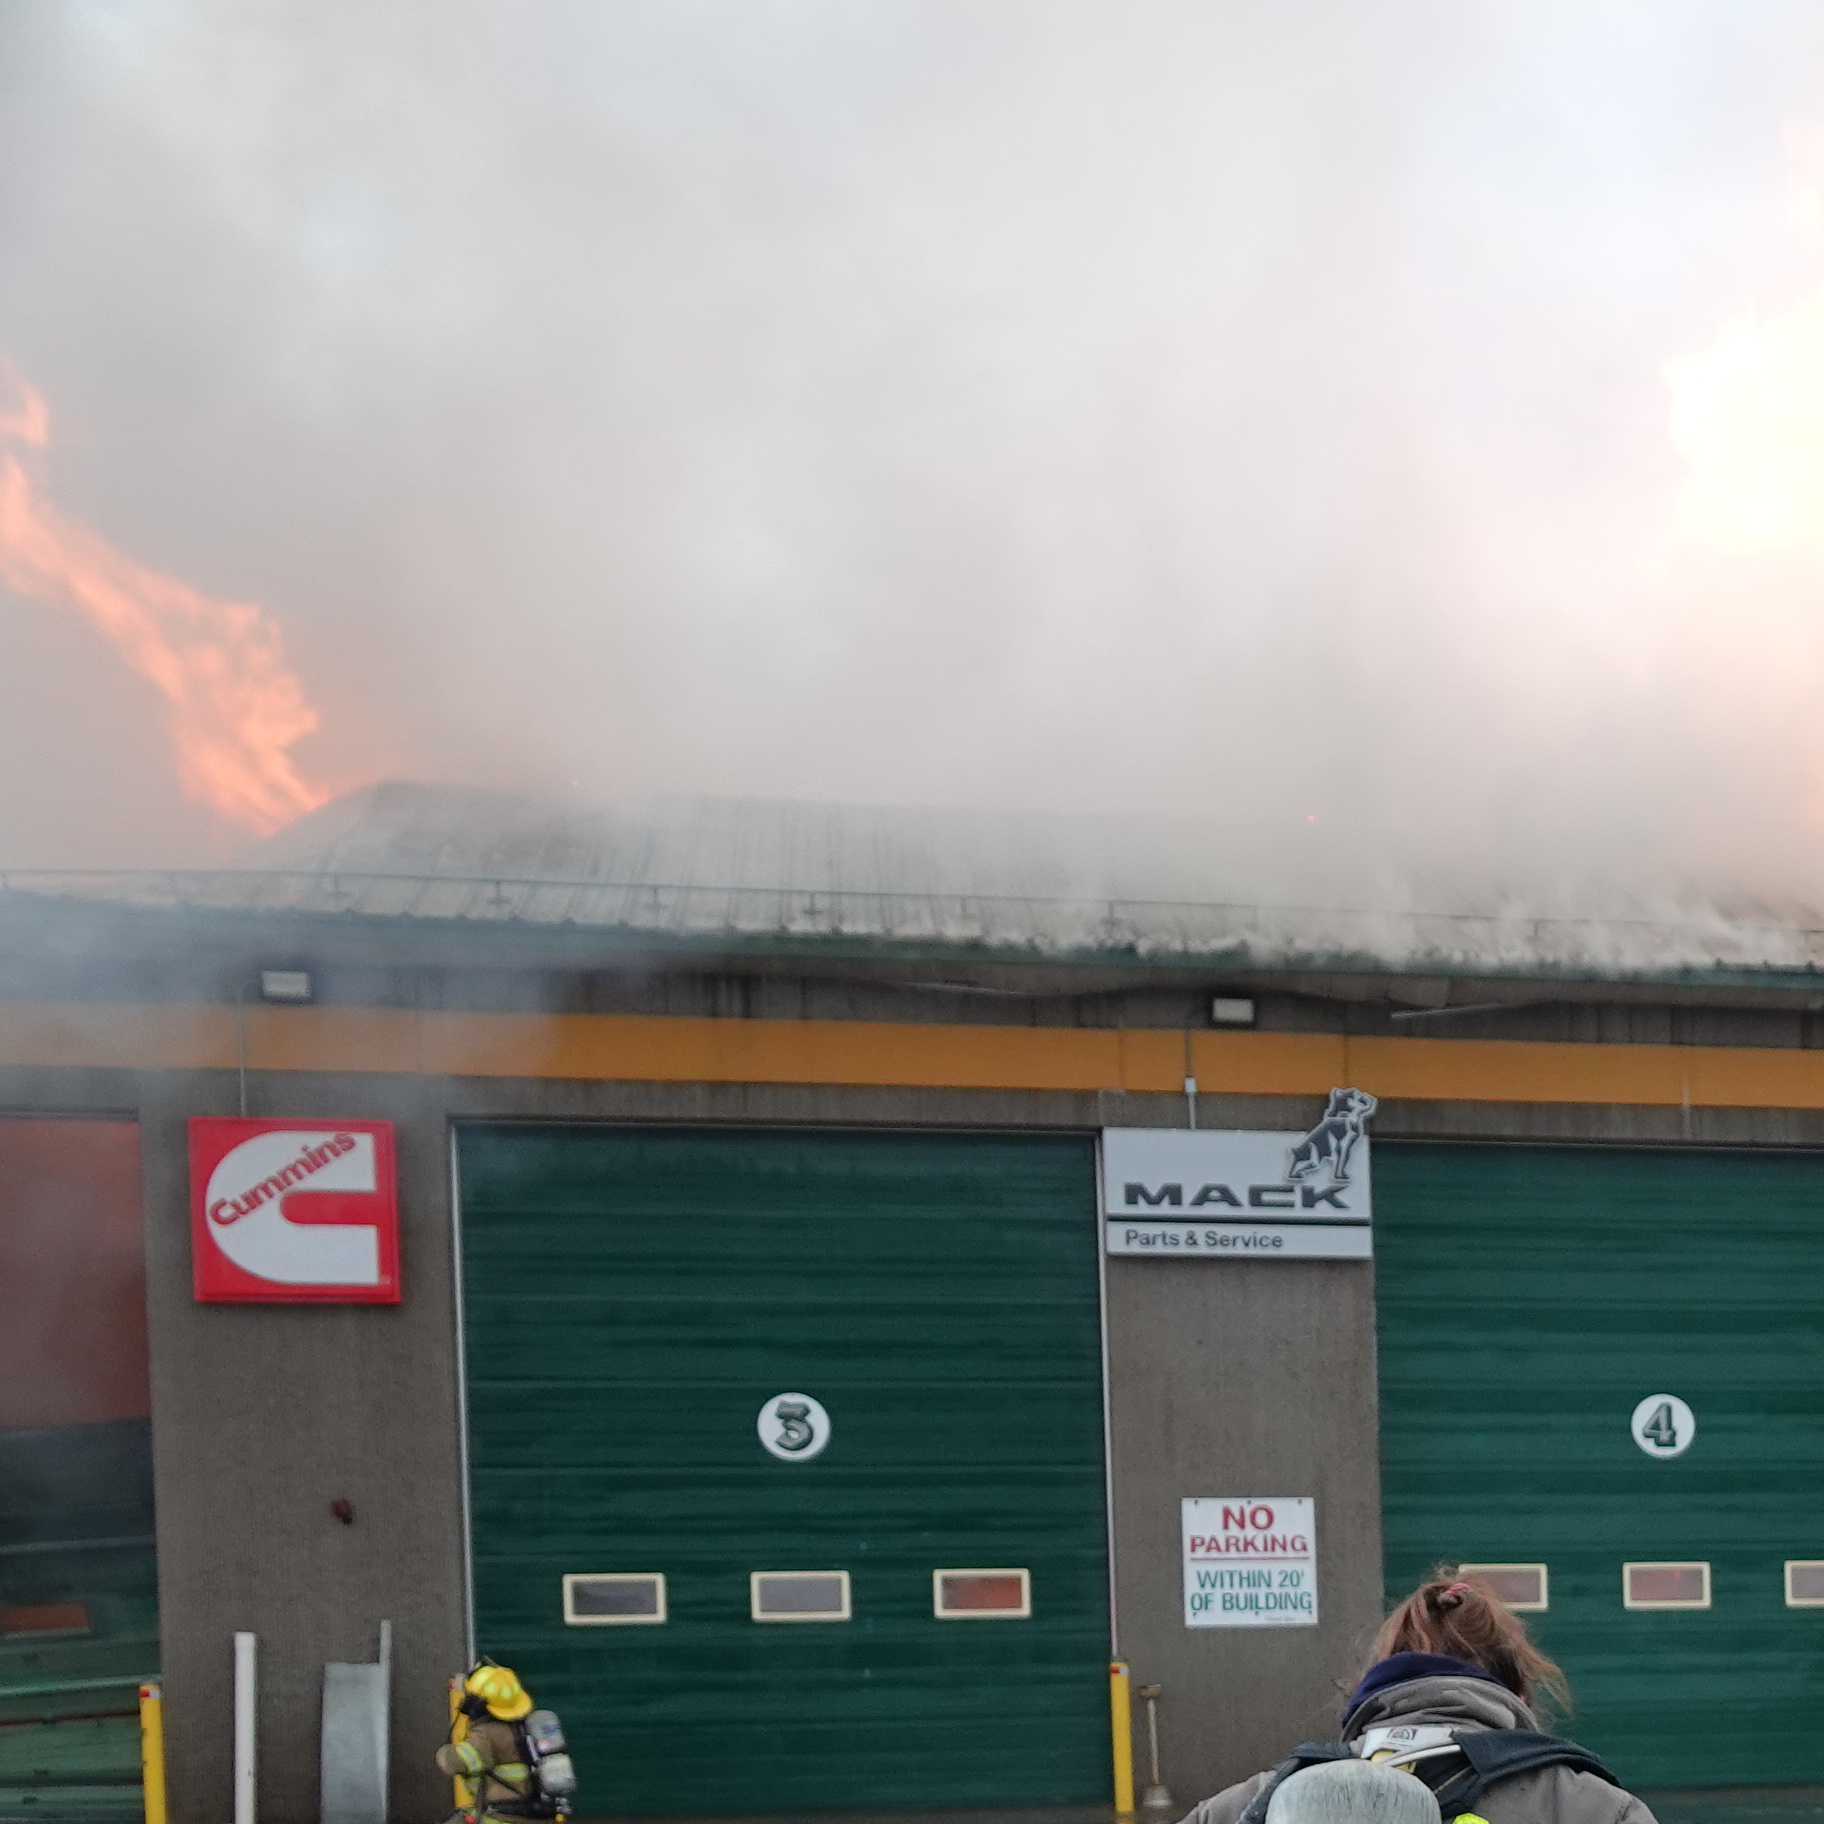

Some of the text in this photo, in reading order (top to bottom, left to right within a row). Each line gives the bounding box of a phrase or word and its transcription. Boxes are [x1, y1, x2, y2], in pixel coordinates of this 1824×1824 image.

[210, 1132, 356, 1225] Cummins
[1124, 1182, 1350, 1208] MACK
[1126, 1229, 1283, 1248] Parts & Service
[776, 1401, 814, 1451] 3
[1643, 1402, 1676, 1447] 4
[1222, 1504, 1274, 1530] NO
[1190, 1534, 1308, 1553] PARKING
[1197, 1569, 1271, 1588] WITHIN
[1190, 1591, 1312, 1611] OF BUILDING
